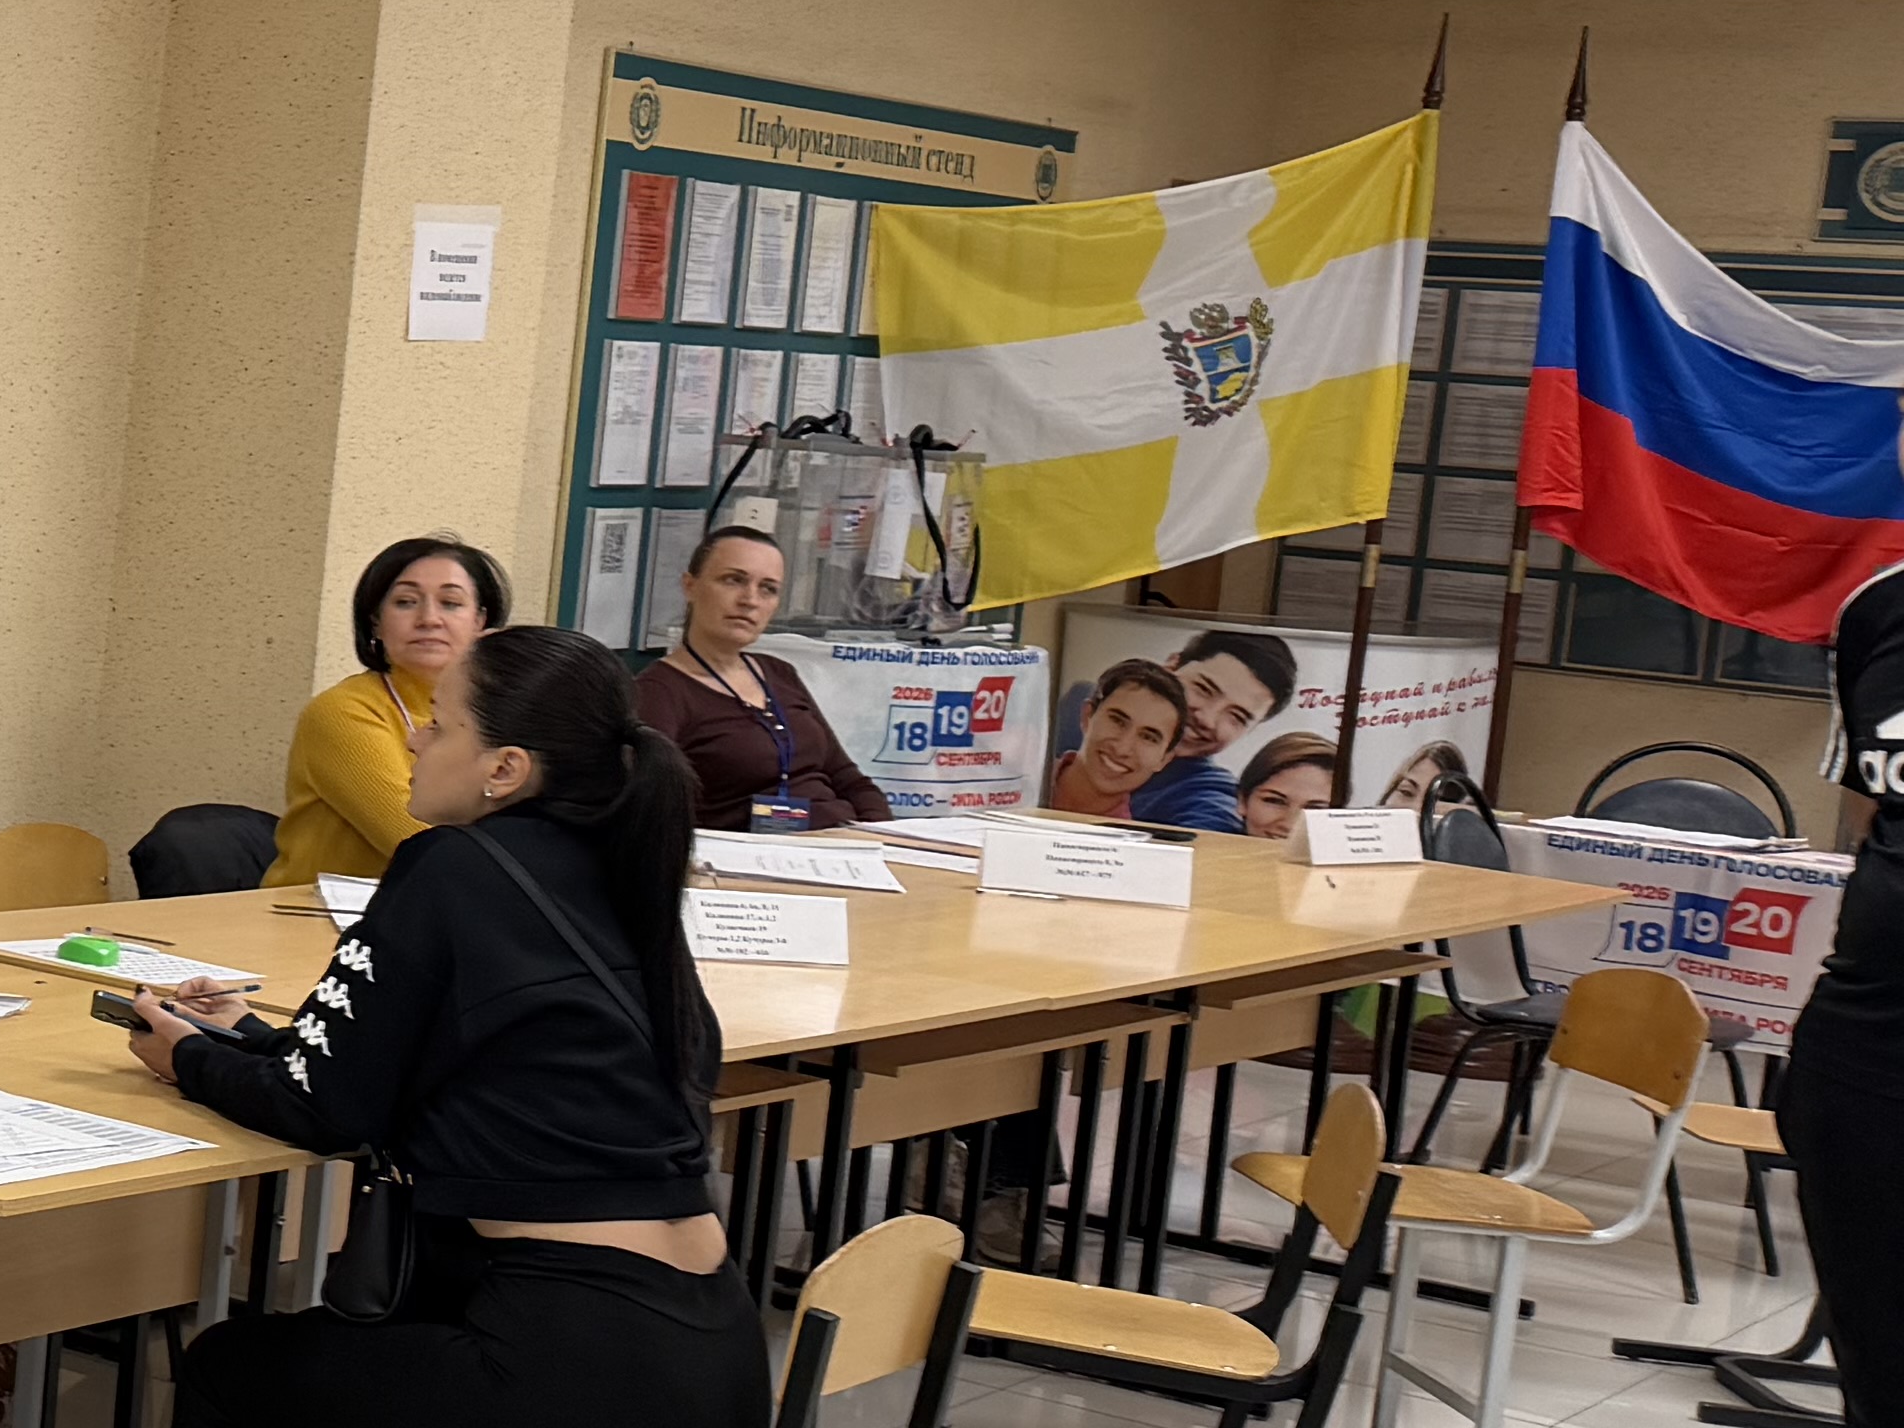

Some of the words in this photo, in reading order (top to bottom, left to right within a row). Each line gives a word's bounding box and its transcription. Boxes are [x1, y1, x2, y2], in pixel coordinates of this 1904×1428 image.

[737, 106, 923, 170] Информационный
[926, 146, 976, 185] стенд
[832, 645, 913, 664] ЕДИНЫЙ
[917, 651, 961, 666] ДЕНЬ
[892, 686, 933, 700] 2026
[893, 721, 929, 752] 18
[937, 705, 969, 736] 19
[973, 689, 1005, 719] 20
[1335, 703, 1451, 730] оступай
[886, 792, 934, 807] ОЛОС
[1547, 834, 1642, 859] ЕДИНЫЙ
[1647, 844, 1710, 866] ДЕНЬ
[1618, 920, 1665, 953] 18
[1678, 908, 1720, 943] 19
[1730, 902, 1793, 939] 20
[1677, 958, 1789, 991] СЕНТЯБРЯ
